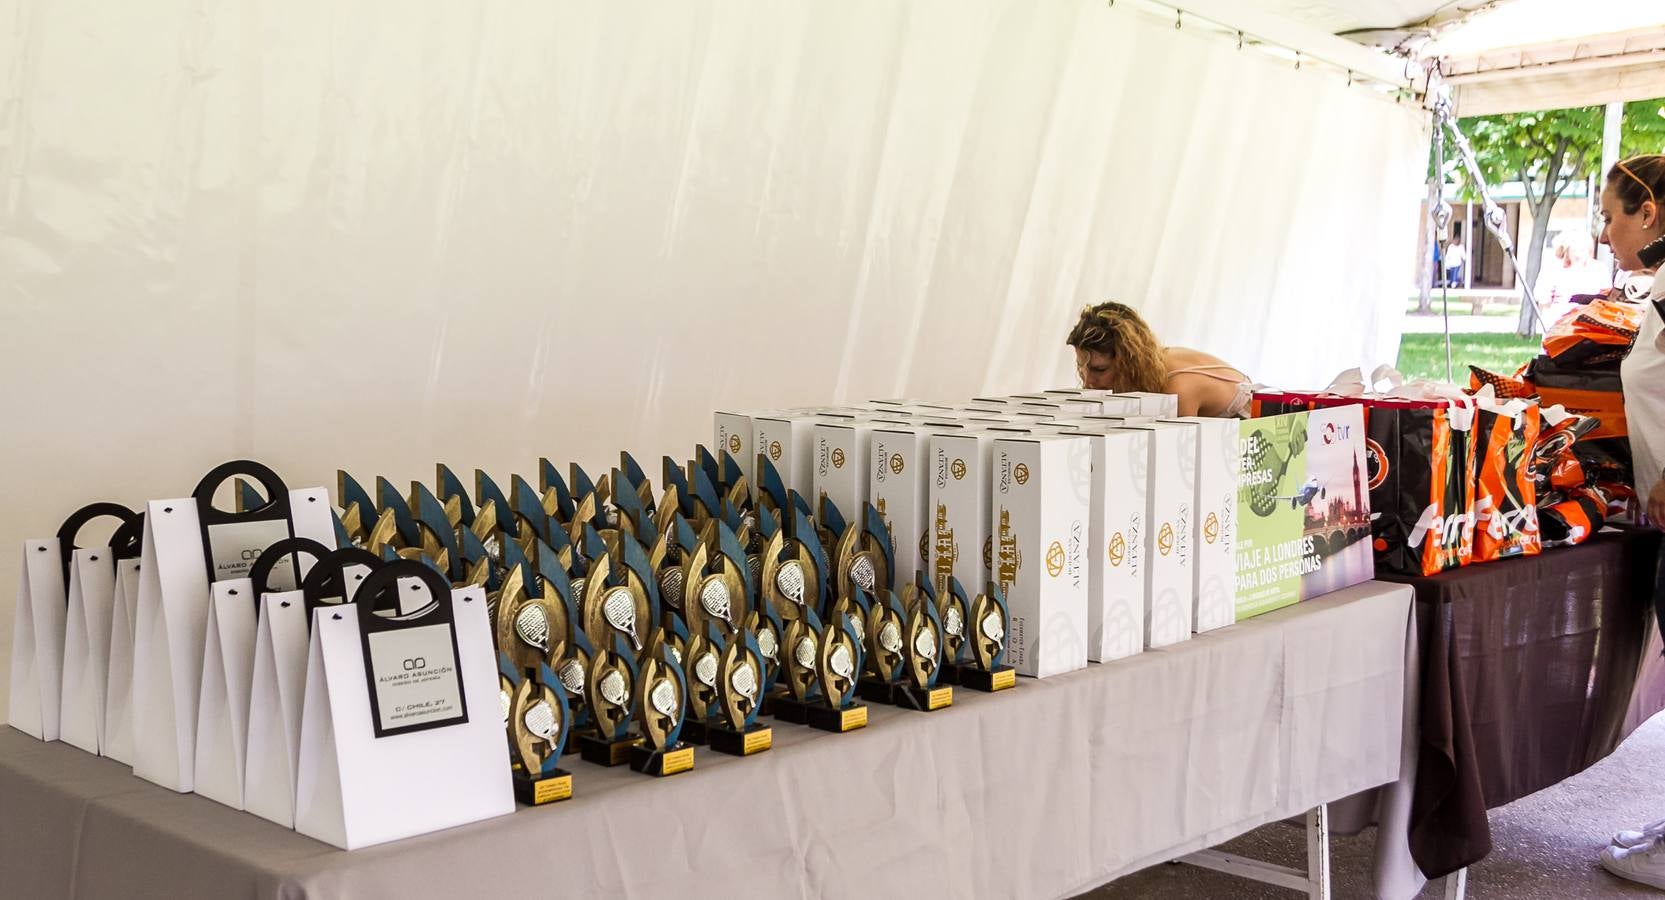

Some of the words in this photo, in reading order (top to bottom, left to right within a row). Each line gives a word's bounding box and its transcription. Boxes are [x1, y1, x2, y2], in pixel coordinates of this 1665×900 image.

[1239, 436, 1259, 456] DEL
[1337, 423, 1349, 440] tvr
[877, 442, 885, 483] ALTANZA
[937, 447, 946, 489] ALTANZA
[1000, 452, 1009, 494] ALTANZA
[1238, 468, 1272, 487] PRESAS
[1071, 520, 1082, 590] ALTANZA
[1235, 548, 1261, 573] VIAJE
[1264, 547, 1271, 565] A
[1272, 535, 1314, 562] LONDRES
[1235, 572, 1258, 593] PARA
[1260, 566, 1277, 586] DOS
[1280, 554, 1321, 580] PERSONAS
[412, 667, 453, 677] ASUNCIÓN
